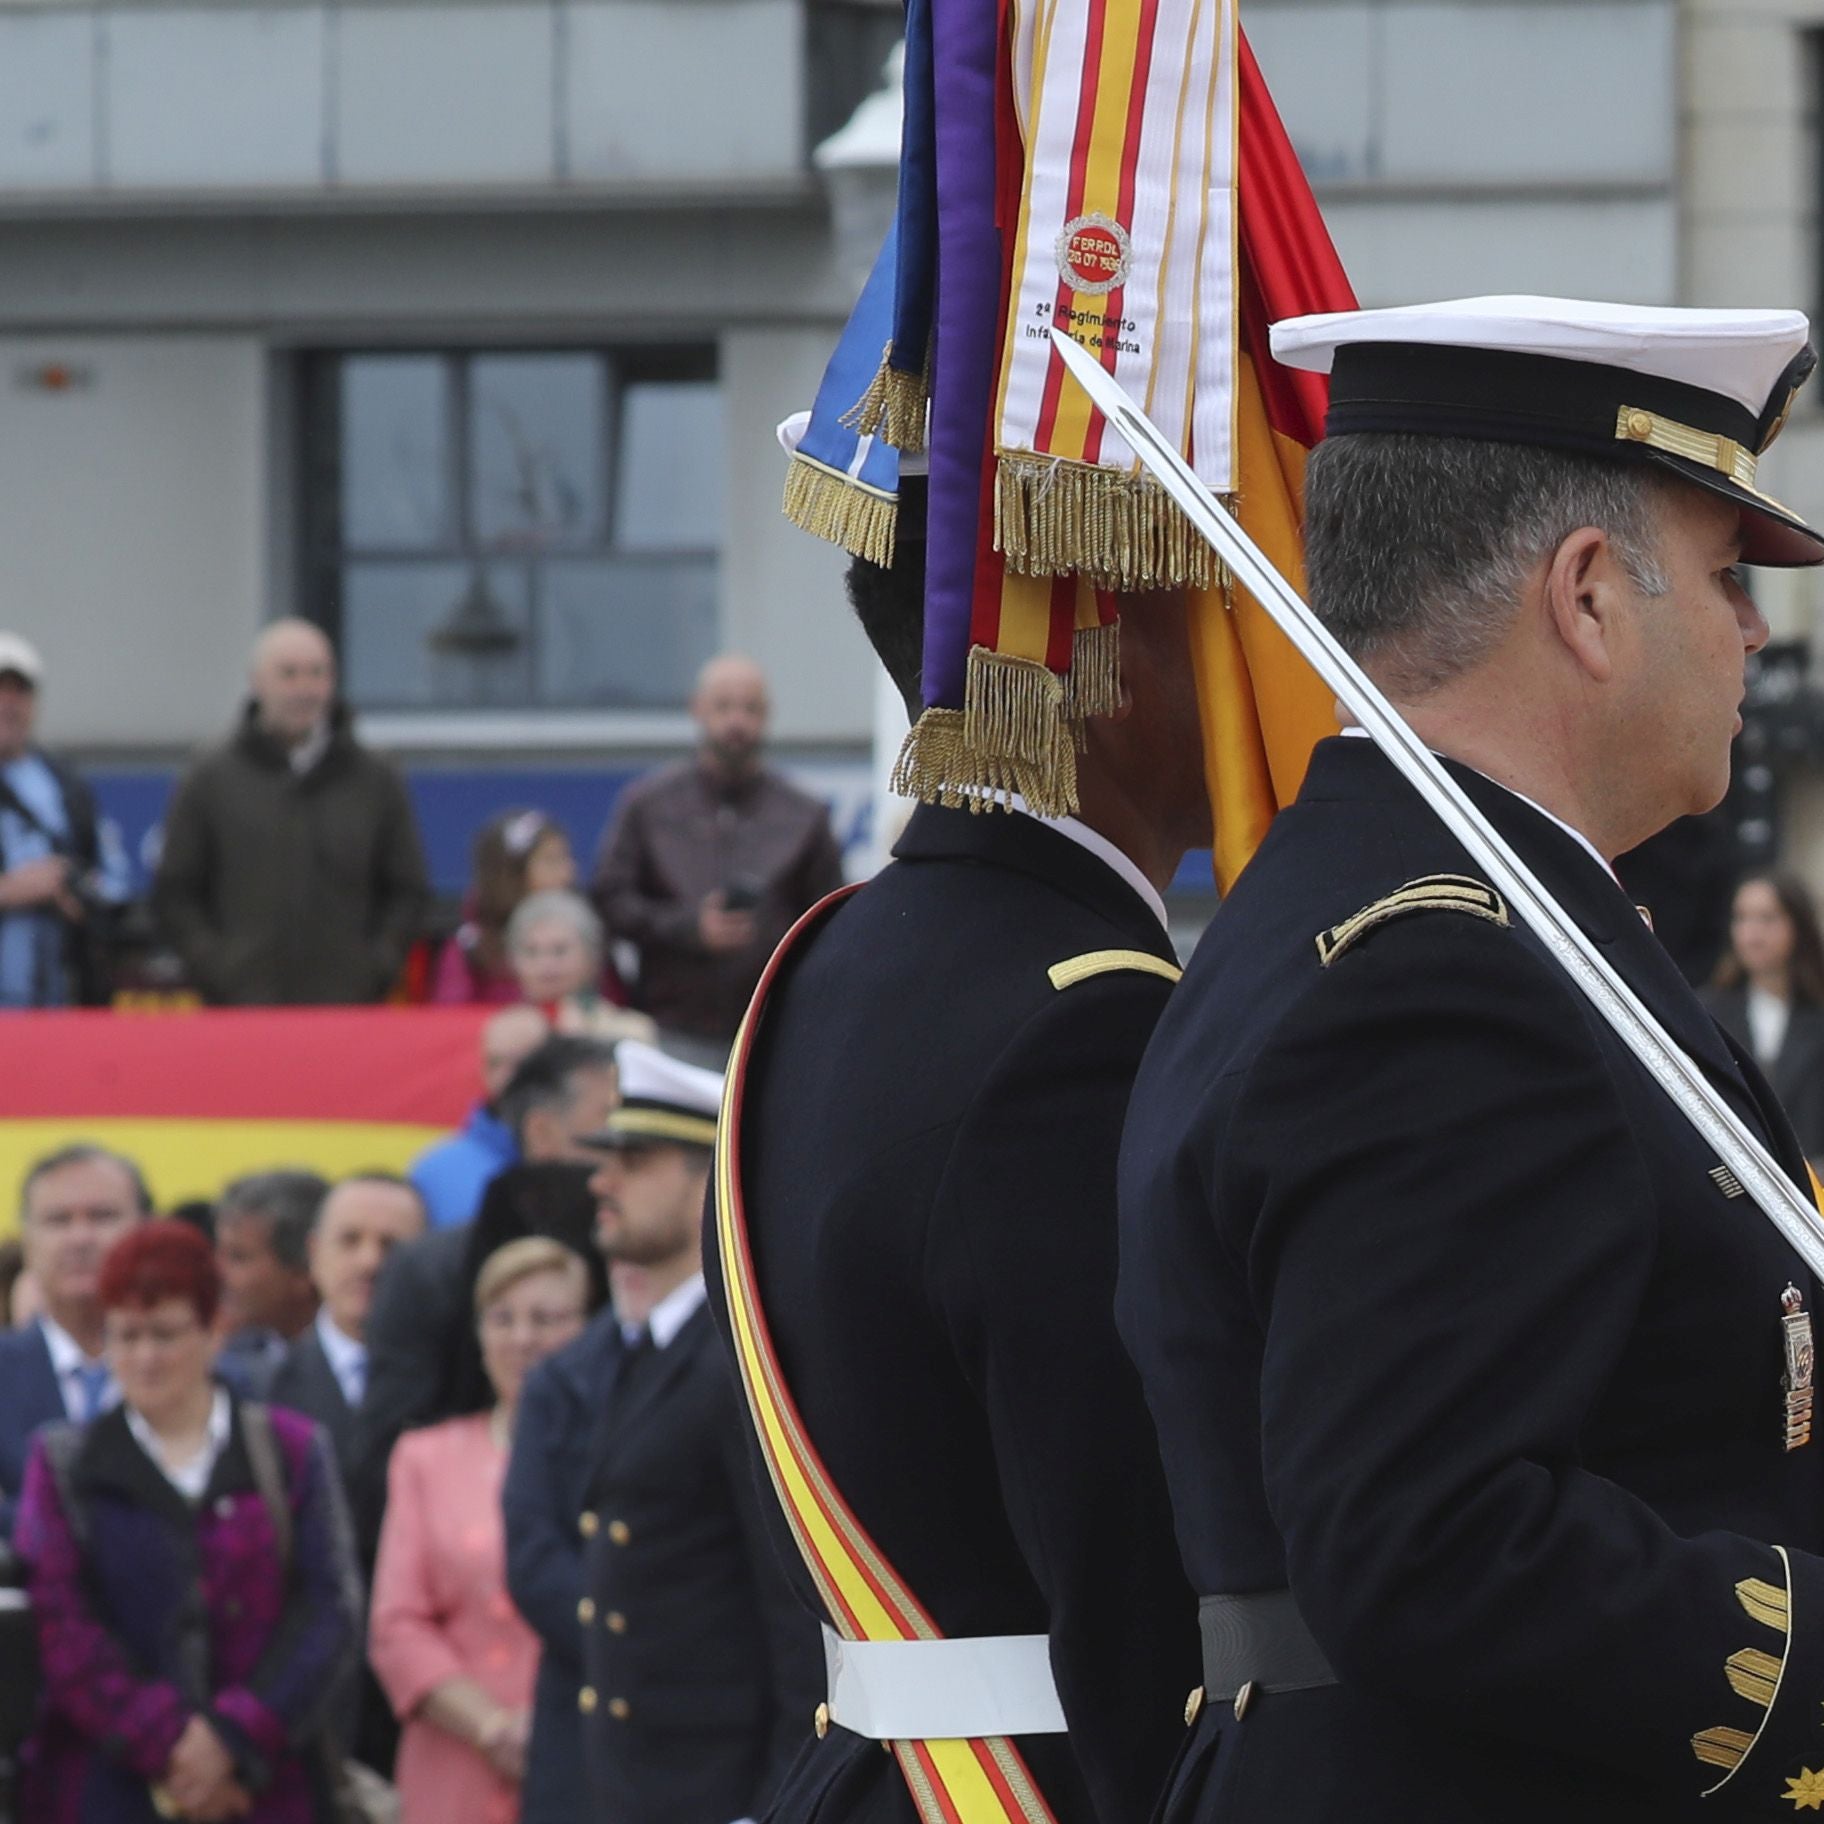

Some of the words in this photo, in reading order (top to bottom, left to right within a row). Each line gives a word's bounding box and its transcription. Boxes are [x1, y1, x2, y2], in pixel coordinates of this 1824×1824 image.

[1073, 236, 1119, 256] FERROL
[1058, 304, 1136, 332] Regimiento
[1090, 334, 1103, 348] de
